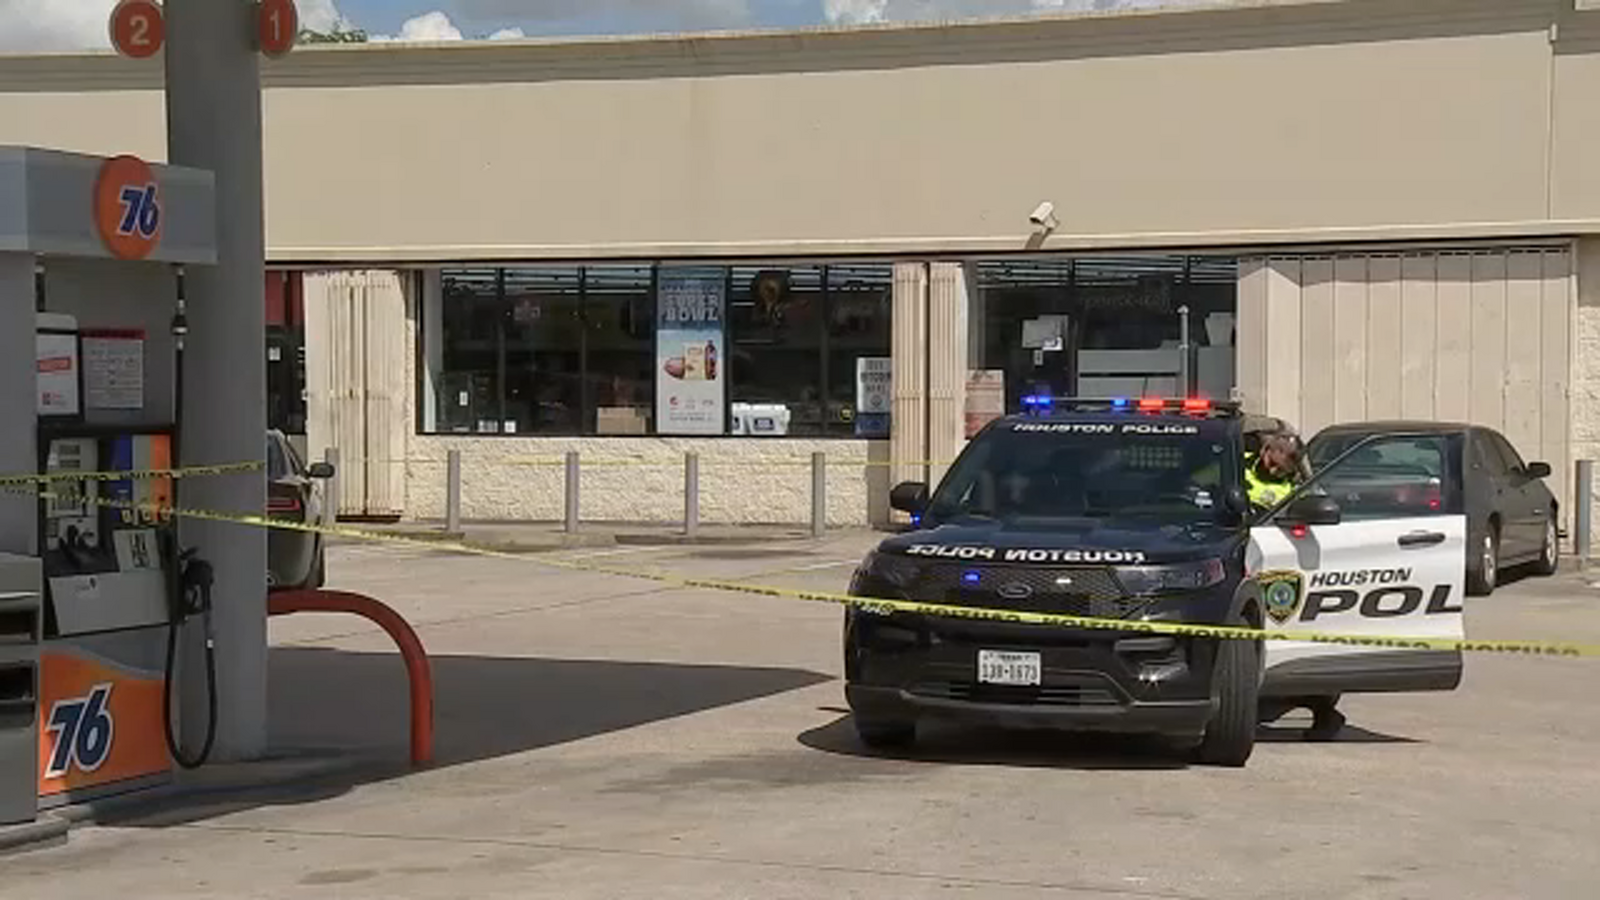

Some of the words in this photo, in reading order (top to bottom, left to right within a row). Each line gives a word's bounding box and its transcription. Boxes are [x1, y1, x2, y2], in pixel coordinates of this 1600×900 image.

[129, 15, 150, 46] 2
[269, 9, 281, 41] 1
[118, 183, 159, 237] 76
[1014, 421, 1114, 434] HOUSTON
[1121, 423, 1198, 435] POLICE
[1310, 568, 1412, 588] HOUSTON
[1299, 584, 1463, 622] POL
[45, 683, 114, 779] 76
